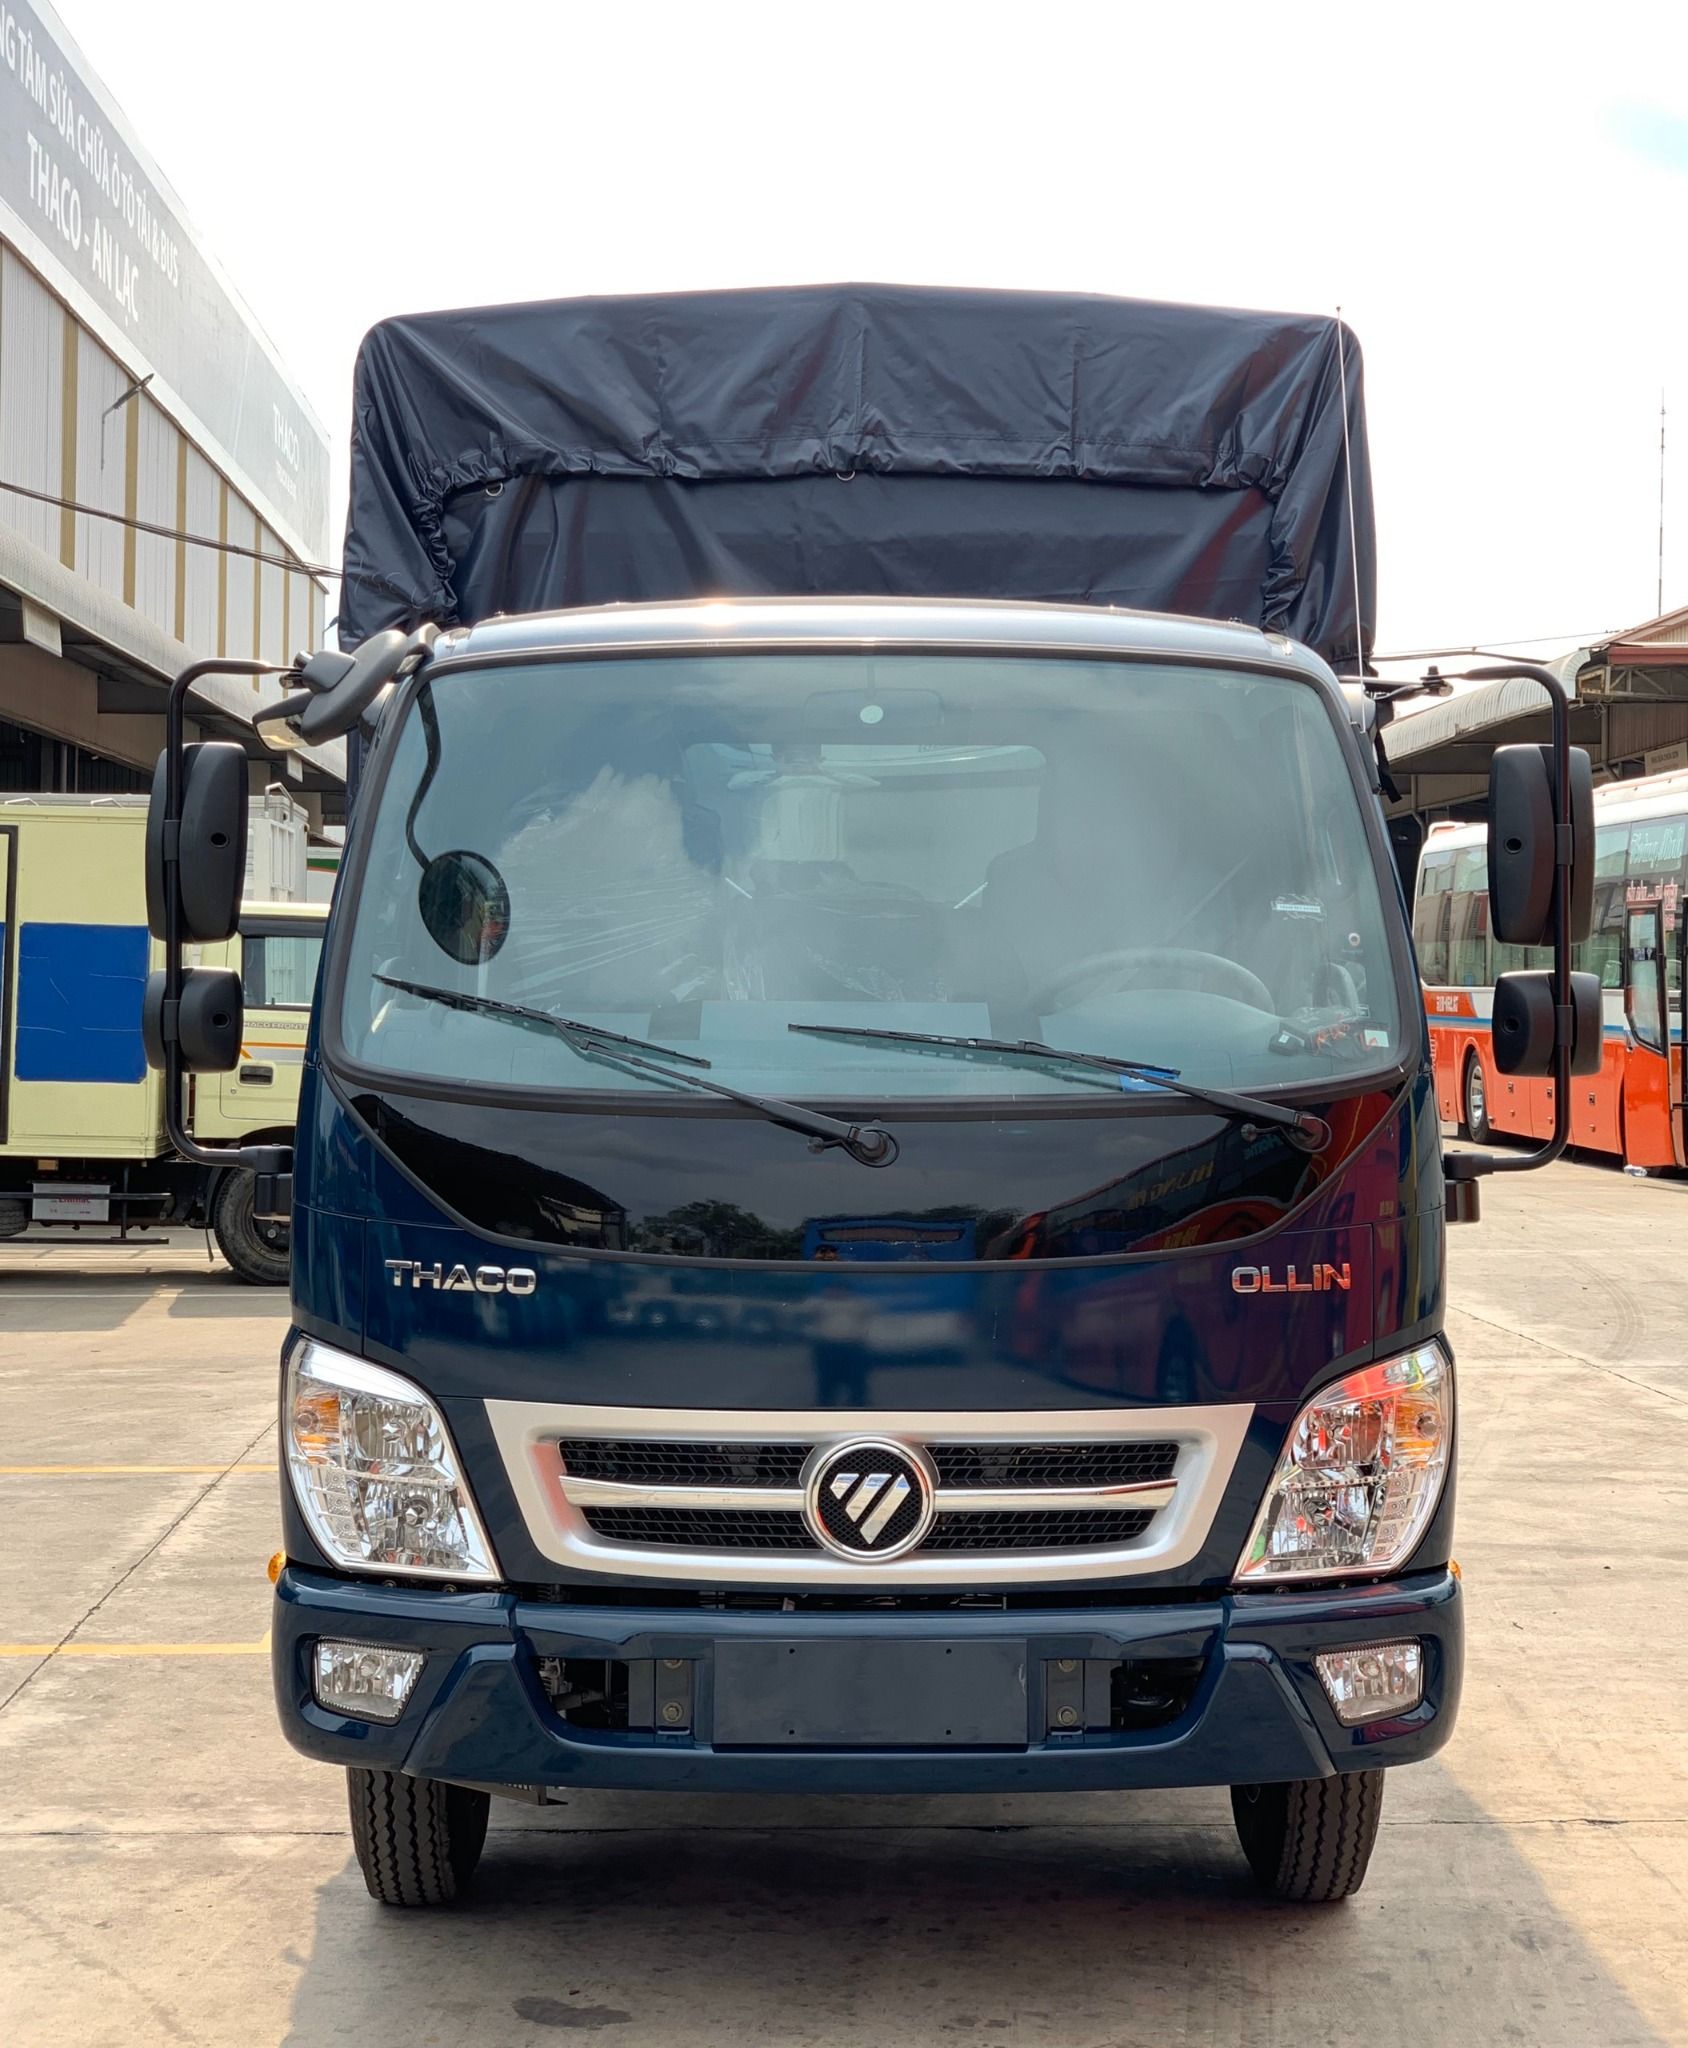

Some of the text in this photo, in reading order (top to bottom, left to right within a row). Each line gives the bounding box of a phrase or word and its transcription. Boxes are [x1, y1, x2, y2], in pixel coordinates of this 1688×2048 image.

[18, 26, 47, 115] TÂM
[49, 70, 76, 152] SỬA
[77, 113, 110, 198] CHỮA
[111, 152, 120, 208] Ô
[121, 171, 135, 228] TÔ
[160, 229, 178, 287] BUS
[27, 130, 82, 251] THACO
[92, 216, 112, 291] AN
[114, 242, 139, 327] LẠC
[273, 402, 299, 472] THACO
[384, 1259, 537, 1296] THACO
[1231, 1263, 1351, 1293] OLLIN
